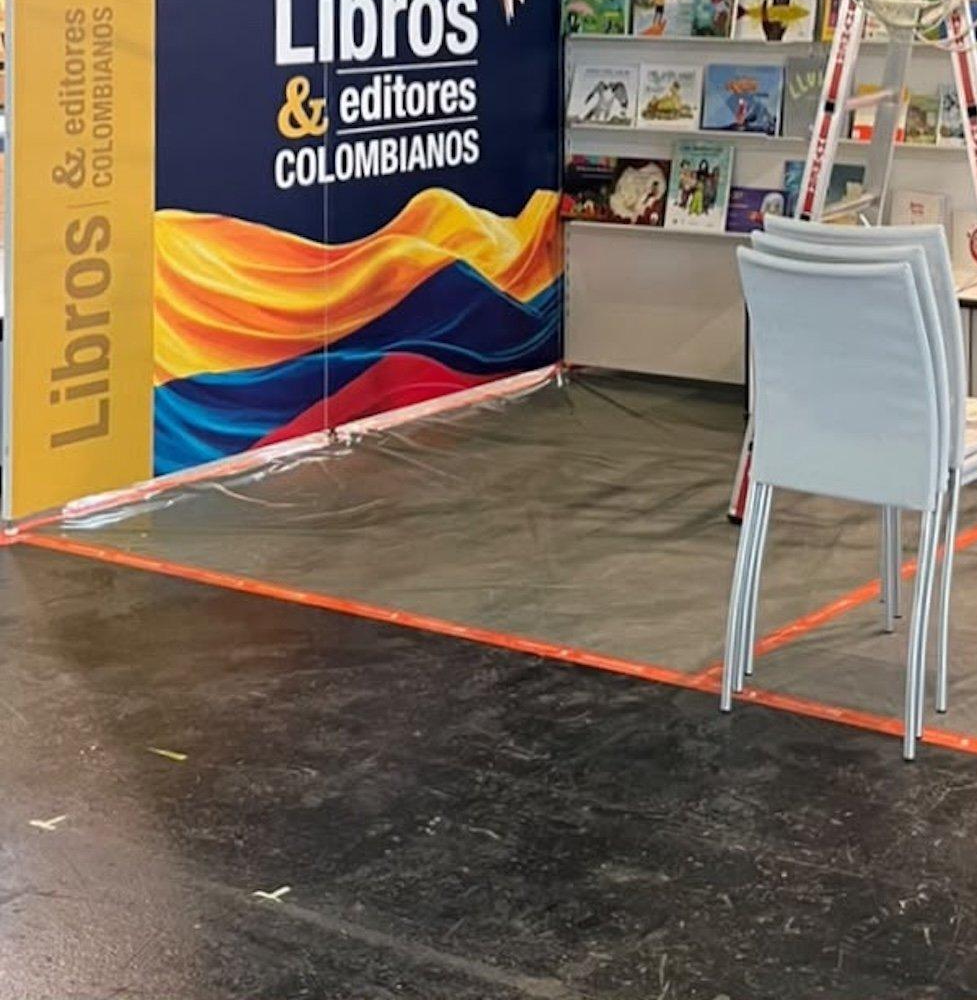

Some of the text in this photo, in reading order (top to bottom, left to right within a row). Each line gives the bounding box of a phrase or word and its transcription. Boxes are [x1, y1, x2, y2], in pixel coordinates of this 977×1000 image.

[91, 6, 115, 189] COLOMBIANOS
[275, 129, 480, 189] COLOMBIANOS
[276, 75, 478, 140] & editores
[50, 8, 113, 449] Libros & editores
